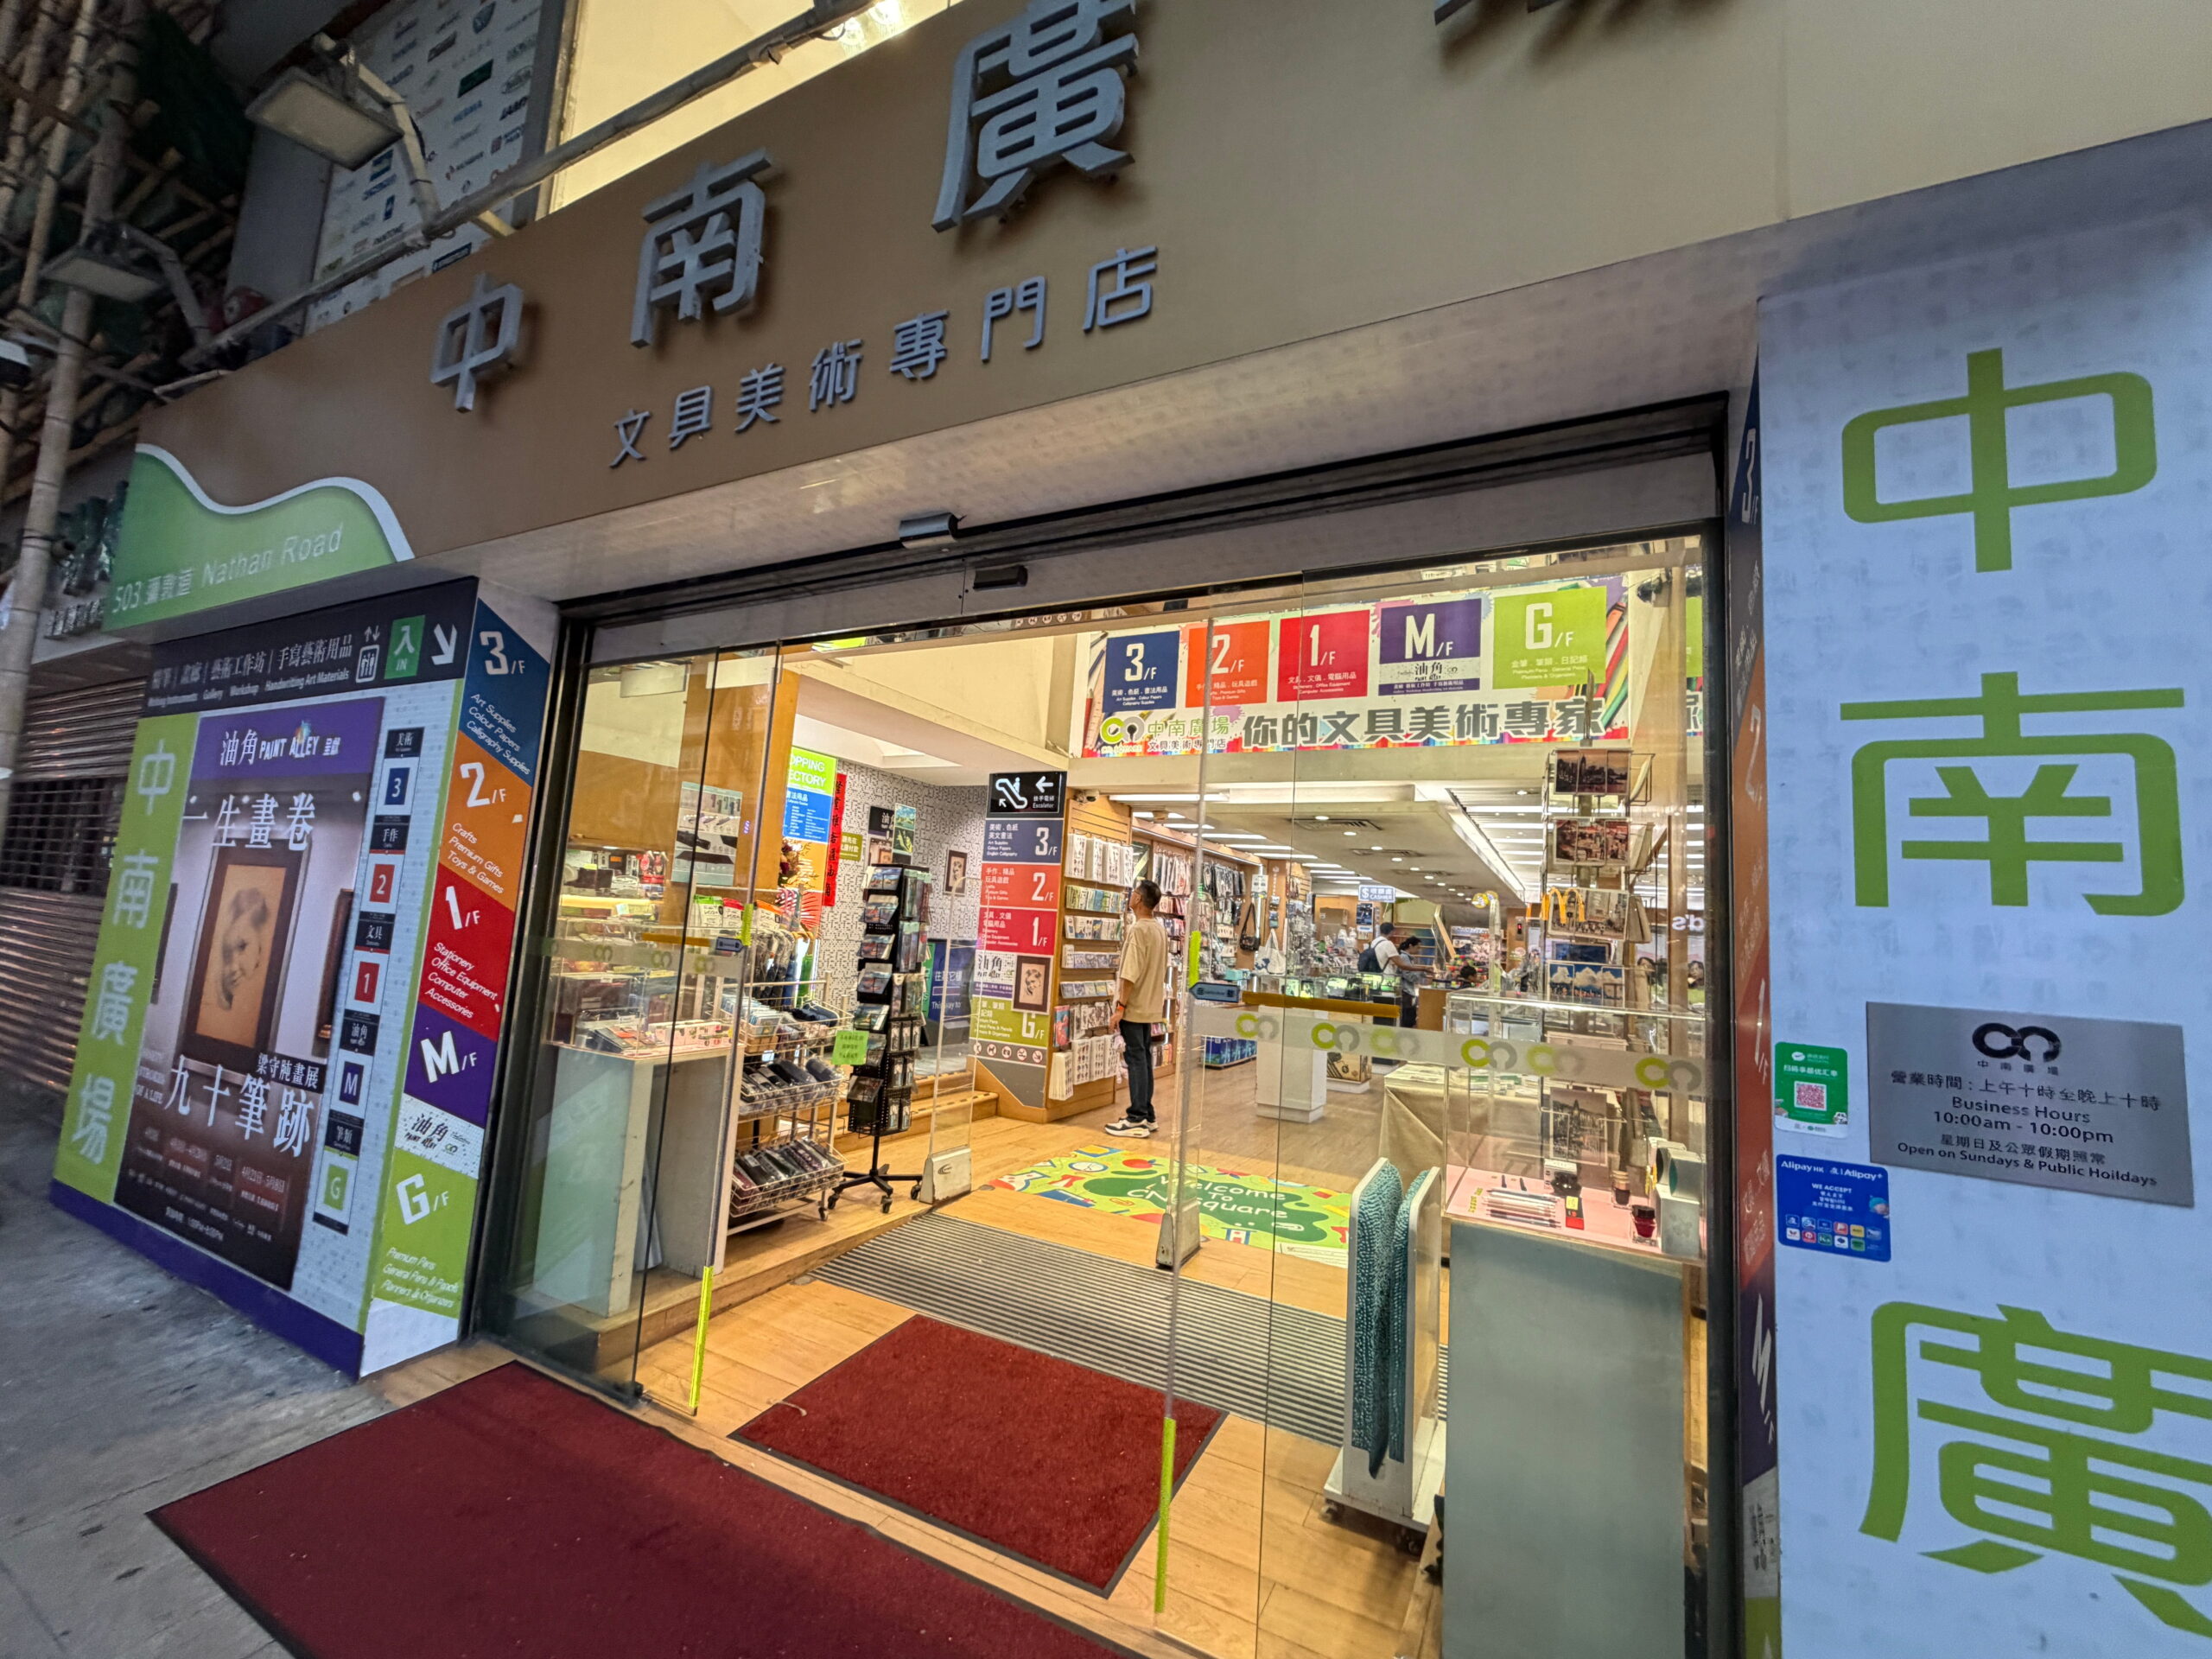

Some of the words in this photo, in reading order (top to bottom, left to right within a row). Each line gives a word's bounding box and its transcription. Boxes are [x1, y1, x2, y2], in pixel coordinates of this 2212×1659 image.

[610, 246, 1158, 469] 文具美術專門店
[112, 581, 142, 613] 503
[202, 550, 274, 587] Nathan
[282, 523, 343, 564] Road
[394, 625, 415, 656] 入
[1404, 613, 1453, 660] M/F
[1525, 602, 1574, 650] G/F
[277, 633, 353, 671] 手寫藝術用品
[479, 630, 526, 675] 3/F
[1124, 641, 1158, 682] 3/F
[1210, 633, 1245, 676] 2/F
[1309, 624, 1337, 668] 1/F
[316, 666, 350, 683] Materials
[396, 658, 408, 671] IN
[1414, 661, 1443, 676] 油角
[468, 707, 493, 732] Colour
[493, 727, 521, 753] Papers
[471, 693, 486, 709] Art
[482, 701, 517, 734] Supplies
[1148, 716, 1229, 737] 中南廣場
[1243, 698, 1604, 747] 你的文具美術專家
[220, 729, 258, 766] 油角
[258, 738, 288, 760] PAINT
[289, 736, 320, 759] ALLEY
[466, 721, 503, 754] Calligraphy
[501, 749, 531, 776] Supplies
[391, 777, 401, 798] 3
[460, 761, 507, 808] 2/F
[182, 791, 316, 852] 一生畫卷
[452, 822, 478, 845] Crafts
[448, 836, 484, 865] Premium
[484, 860, 504, 879] Gifts
[1034, 827, 1058, 856] 3/F
[377, 874, 386, 895] 2
[447, 850, 467, 873] Toys
[467, 865, 478, 875] &
[477, 869, 505, 894] Games
[1031, 872, 1054, 901] 2/F
[445, 886, 481, 931] 1/F
[1033, 917, 1048, 947] 1/F
[434, 942, 474, 972] Stationery
[363, 972, 372, 994] 1
[428, 971, 469, 1001] Computer
[431, 957, 457, 977] Office
[455, 972, 499, 1002] Equipment
[424, 987, 474, 1020] Accessories
[1021, 1013, 1046, 1039] G/F
[420, 1030, 478, 1084] M/F
[343, 1072, 359, 1097] M
[164, 1053, 315, 1158] 九十筆跡
[1952, 1096, 2030, 1116] Business
[2034, 1105, 2091, 1123] Hours
[411, 1113, 449, 1142] 油角
[1934, 1110, 2012, 1131] 10:00am
[2030, 1122, 2113, 1143] 10:00pm
[1897, 1141, 1935, 1156] Open
[1938, 1149, 1955, 1160] on
[1960, 1150, 2019, 1169] Sundays
[2024, 1159, 2034, 1169] &
[2038, 1160, 2085, 1176] Public
[330, 1176, 342, 1200] G
[396, 1173, 450, 1225] G/F
[1209, 1192, 1234, 1202] To
[1811, 1182, 1823, 1191] WE
[1824, 1185, 1852, 1194] ACCEPT
[416, 1256, 436, 1271] Pens
